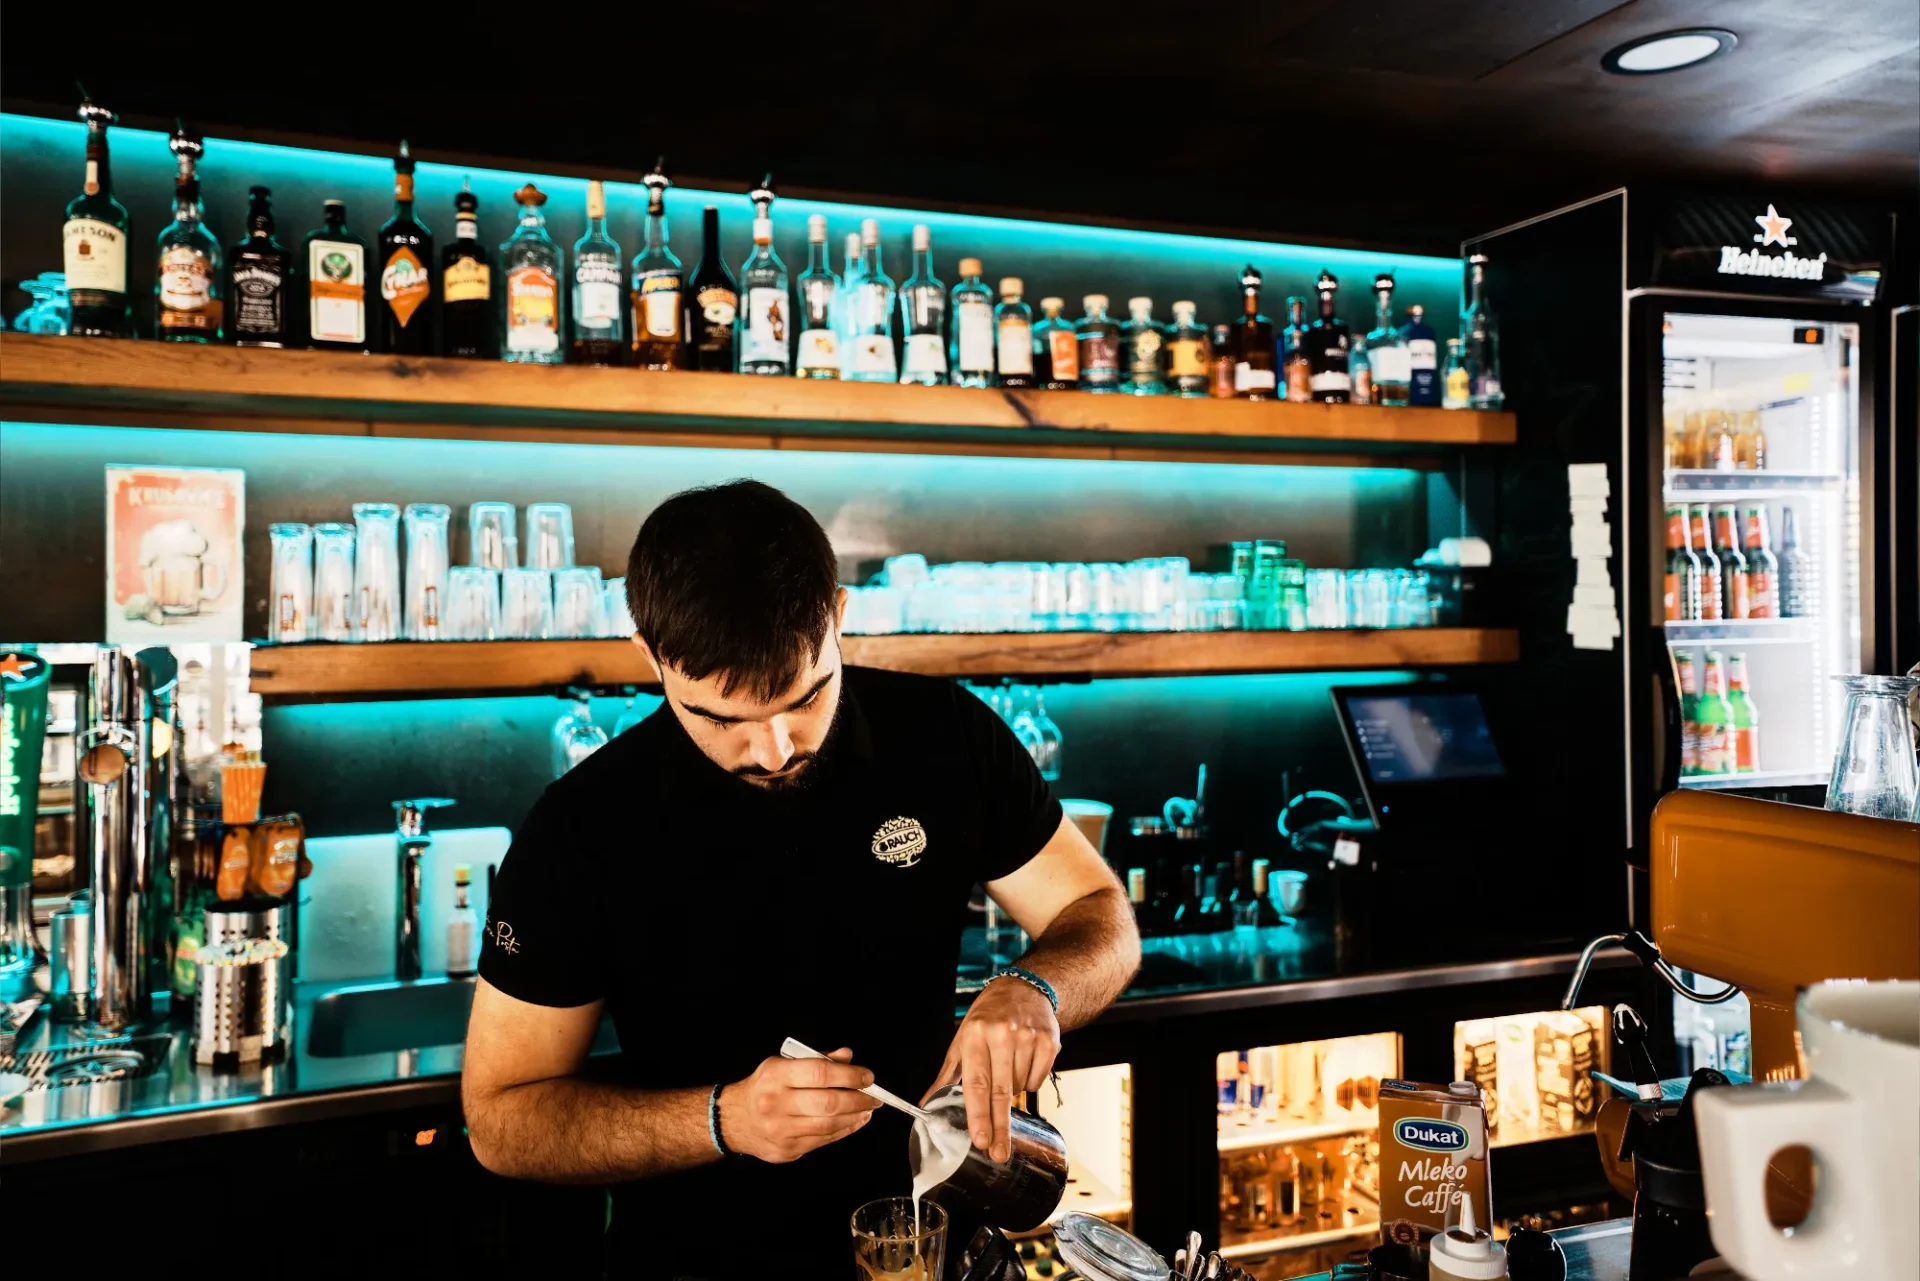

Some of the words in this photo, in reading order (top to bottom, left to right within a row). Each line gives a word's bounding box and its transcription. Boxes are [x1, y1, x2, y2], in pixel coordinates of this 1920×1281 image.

[1717, 246, 1823, 280] Heineken
[887, 828, 921, 849] RAUCH
[1404, 1125, 1459, 1145] Dukat
[1398, 1157, 1468, 1182] Mleko
[1404, 1183, 1465, 1214] Caffé
